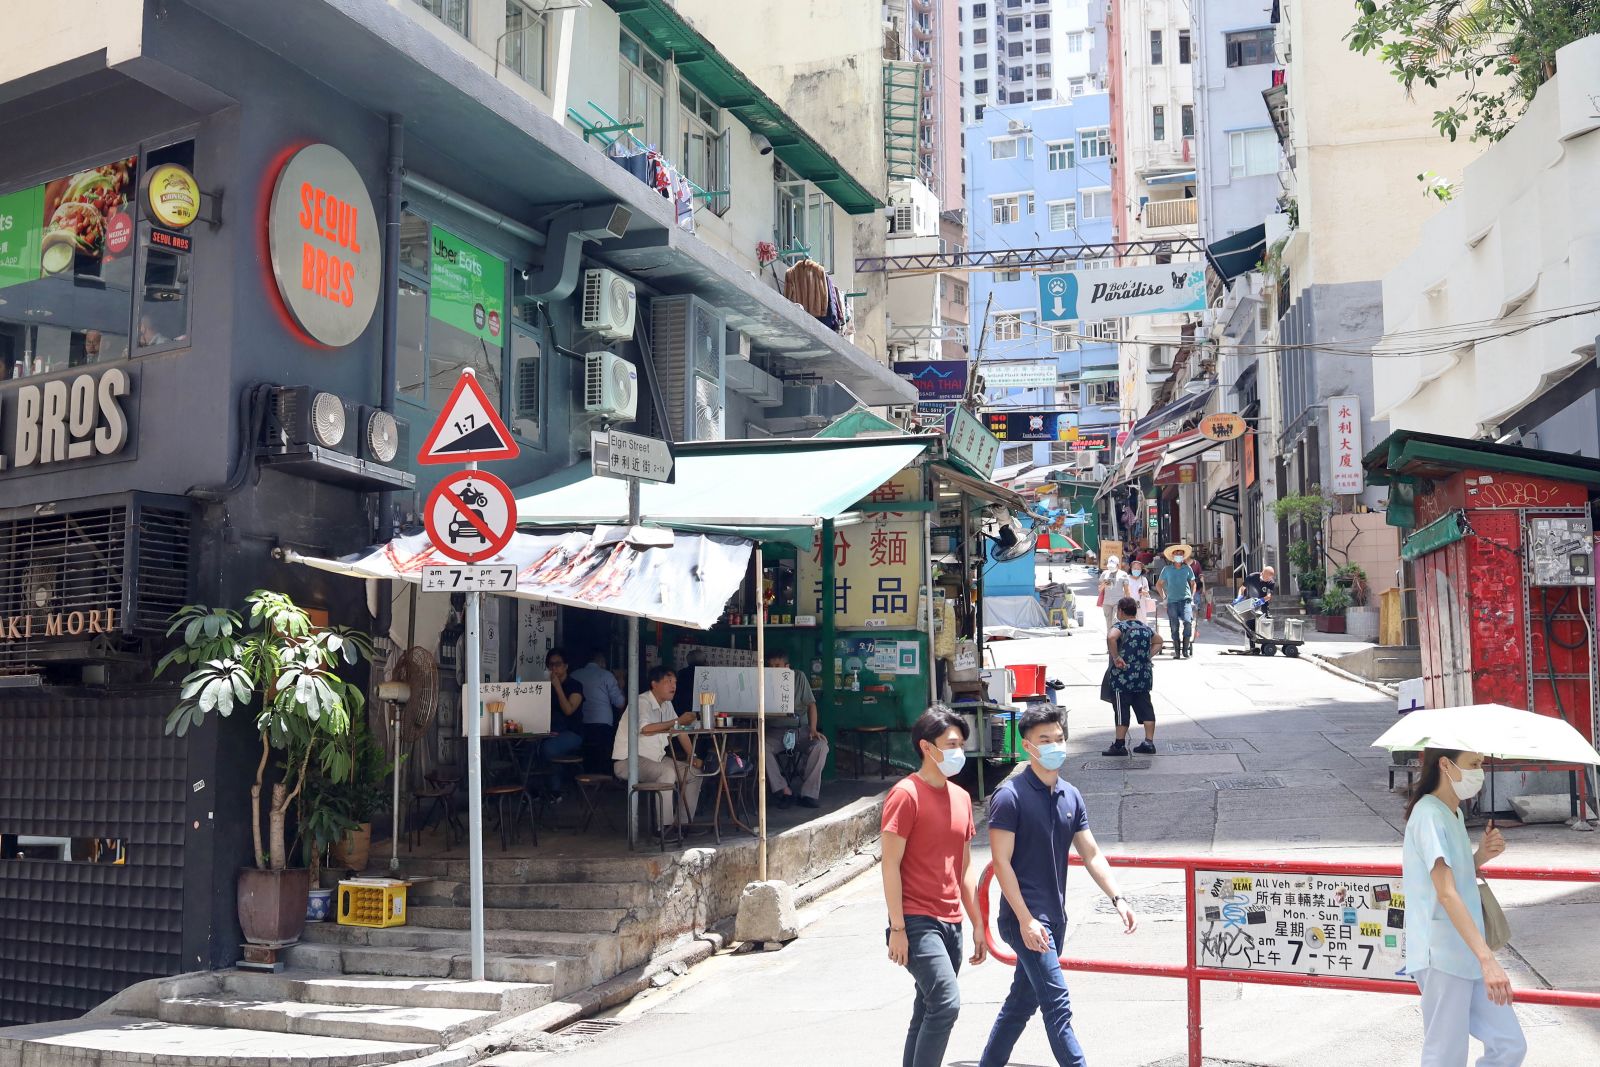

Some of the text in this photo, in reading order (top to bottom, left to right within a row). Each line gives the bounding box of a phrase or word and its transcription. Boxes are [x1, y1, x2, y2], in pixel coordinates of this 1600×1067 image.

[299, 182, 361, 254] SEOUL
[108, 228, 130, 239] MEXICAN
[110, 236, 127, 246] HOUSE
[152, 231, 189, 250] SEOUL BROS
[433, 237, 458, 264] Uber
[459, 250, 482, 277] Eats
[302, 241, 355, 308] BROS
[1091, 281, 1165, 304] Paradise
[1109, 280, 1137, 292] Bob's
[938, 379, 962, 390] THAI
[15, 368, 130, 468] BROS
[454, 413, 475, 435] 1:7
[628, 438, 650, 454] Street
[1338, 404, 1352, 468] 永利大廈
[611, 453, 651, 474] 伊利近街
[813, 528, 907, 567] 粉麵
[426, 579, 496, 589] 上午 下午
[449, 569, 462, 587] 7
[500, 569, 513, 587] 7
[813, 577, 907, 614] 甜品
[45, 607, 115, 637] MORI
[1233, 882, 1252, 891] XEME
[1255, 878, 1270, 888] All
[1271, 879, 1313, 890] Vehs
[1283, 908, 1309, 920] Mon.
[1318, 910, 1341, 922] Sun.
[1274, 921, 1352, 940] 星期至日
[1360, 928, 1382, 937] XEME
[1252, 949, 1353, 971] 上午 下午
[1258, 937, 1276, 946] am
[1287, 941, 1303, 966] 7
[1328, 941, 1347, 952] pm
[1357, 944, 1374, 970] 7
